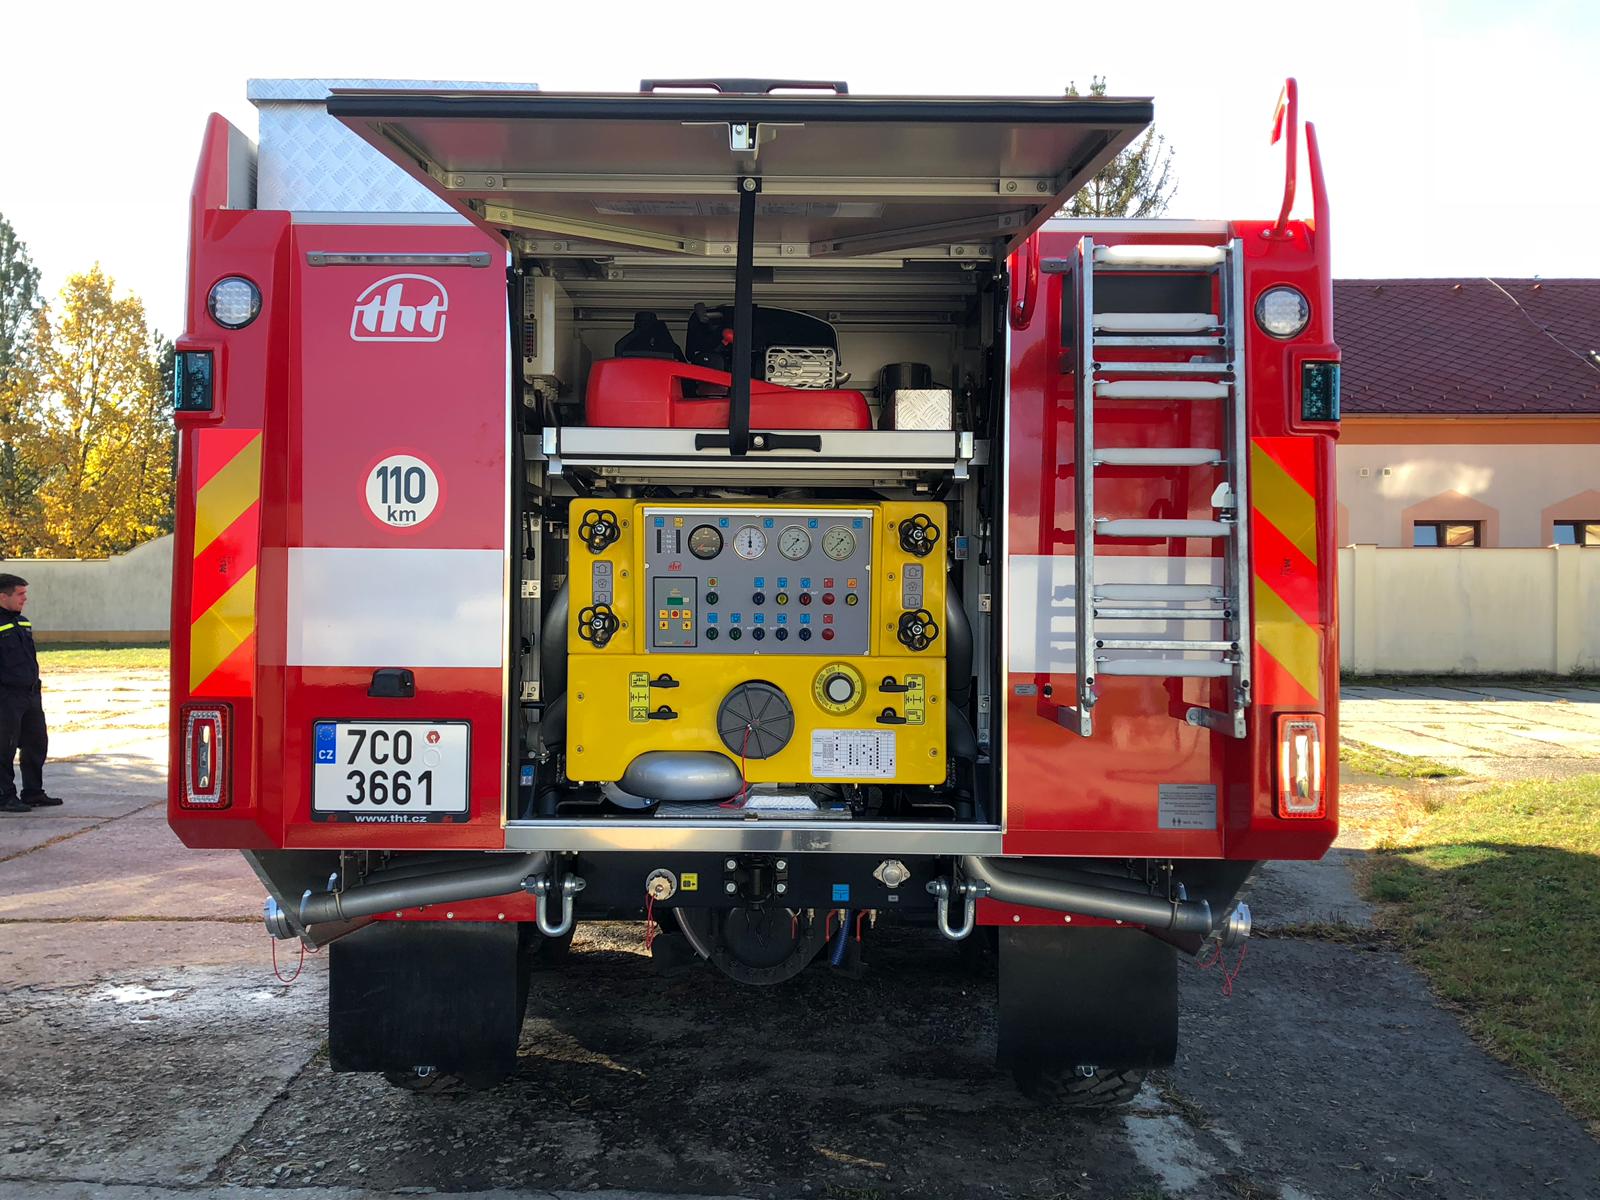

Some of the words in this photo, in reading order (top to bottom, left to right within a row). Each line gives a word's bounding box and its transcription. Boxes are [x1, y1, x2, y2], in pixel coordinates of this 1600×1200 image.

[353, 283, 446, 332] tht
[376, 465, 426, 504] 110
[387, 505, 416, 522] km
[318, 750, 333, 759] CZ
[346, 770, 432, 805] 3661
[354, 815, 427, 823] www.tht.cz
